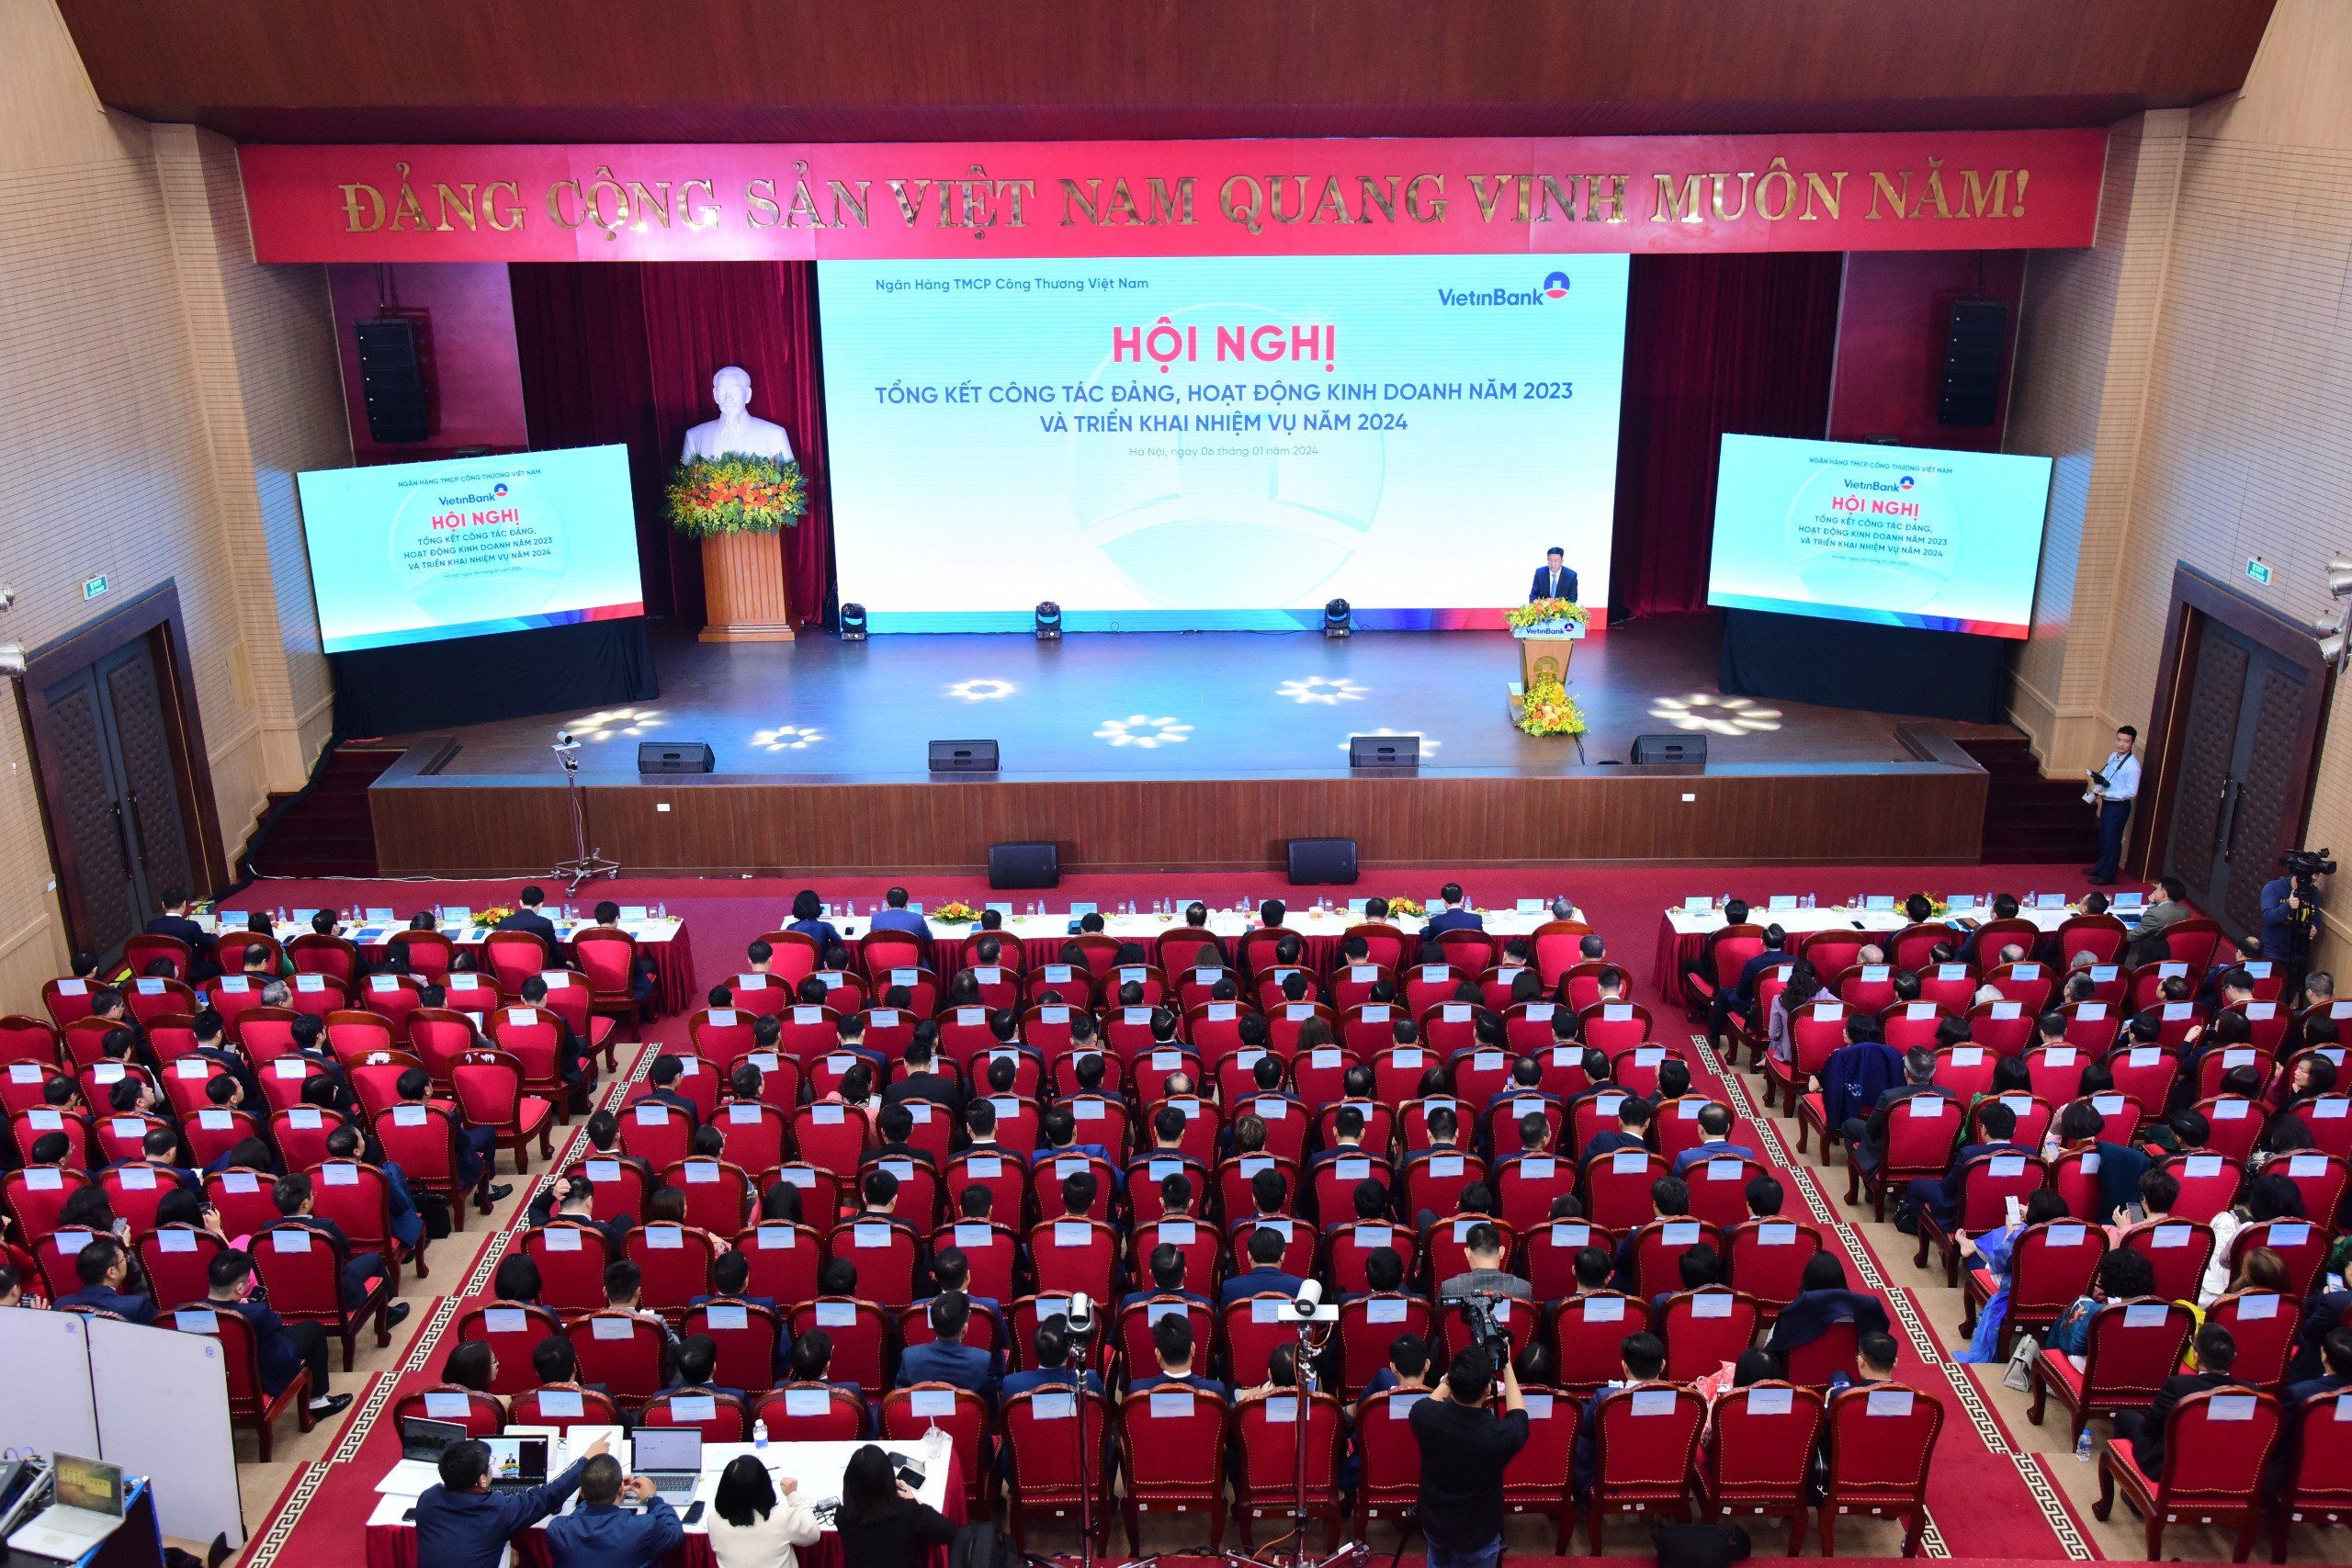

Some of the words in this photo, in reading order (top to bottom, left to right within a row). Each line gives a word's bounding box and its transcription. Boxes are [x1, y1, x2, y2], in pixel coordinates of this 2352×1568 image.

[338, 162, 527, 232] ĐẢNG
[547, 164, 722, 242] CỘNG
[745, 160, 872, 229] SẢN
[887, 164, 1036, 240] VIỆT
[1059, 176, 1200, 227] NAM
[1218, 173, 1449, 236] QUANG
[1465, 173, 1631, 224] VINH
[1649, 156, 1849, 223] MUÔN
[1864, 155, 2030, 220] NĂM!
[876, 279, 911, 293] Ngân
[915, 279, 950, 292] Hàng
[954, 278, 992, 289] TMCP
[995, 278, 1031, 292] Công
[1035, 278, 1085, 291] Thương
[1088, 278, 1115, 292] Việt
[1118, 277, 1148, 288] Nam
[1437, 288, 1544, 306] VietinBank
[1113, 317, 1197, 374] HỘI
[1216, 324, 1335, 373] NGHỊ
[875, 379, 939, 404] TỔNG
[945, 379, 983, 403] KẾT
[989, 381, 1056, 403] CÔNG
[1062, 381, 1104, 402] TÁC
[1111, 379, 1181, 405] ĐẢNG,
[1188, 385, 1247, 407] HOẠT
[1253, 379, 1321, 406] ĐỘNG
[1328, 383, 1377, 400] KINH
[1384, 382, 1463, 400] DOANH
[1469, 378, 1517, 400] NĂM
[1522, 382, 1573, 400] 2023
[1039, 411, 1069, 433] VÀ
[1073, 408, 1133, 433] TRIỂN
[1140, 415, 1189, 433] KHAI
[1195, 410, 1261, 436] NHIỆM
[1267, 413, 1296, 436] VỤ
[1303, 410, 1351, 431] NĂM
[1358, 413, 1408, 431] 2024
[1129, 447, 1145, 457] Hà
[1148, 446, 1168, 458] Nội,
[1170, 446, 1198, 458] ngày
[1201, 446, 1215, 456] 06
[1217, 446, 1250, 457] tháng
[1252, 446, 1263, 456] 01
[1266, 446, 1290, 456] năm
[1293, 446, 1318, 456] 2024
[1844, 479, 1900, 492] VietinBank
[438, 492, 496, 506] VietinBank
[1831, 494, 1866, 515] HỘI
[1871, 500, 1919, 521] NGHỊ
[431, 511, 467, 532] HỘI
[471, 508, 520, 525] NGHỊ
[1798, 525, 1821, 535] HOẠT
[1823, 526, 1849, 536] ĐỘNG
[1850, 531, 1871, 539] KINH
[1872, 533, 1904, 542] DOANH
[1905, 534, 1926, 544] NĂM
[1928, 537, 1948, 546] 2023
[403, 550, 427, 559] HOẠT
[430, 547, 457, 557] ĐỘNG
[458, 545, 479, 553] KINH
[481, 542, 511, 551] DOANH
[513, 538, 532, 547] NĂM
